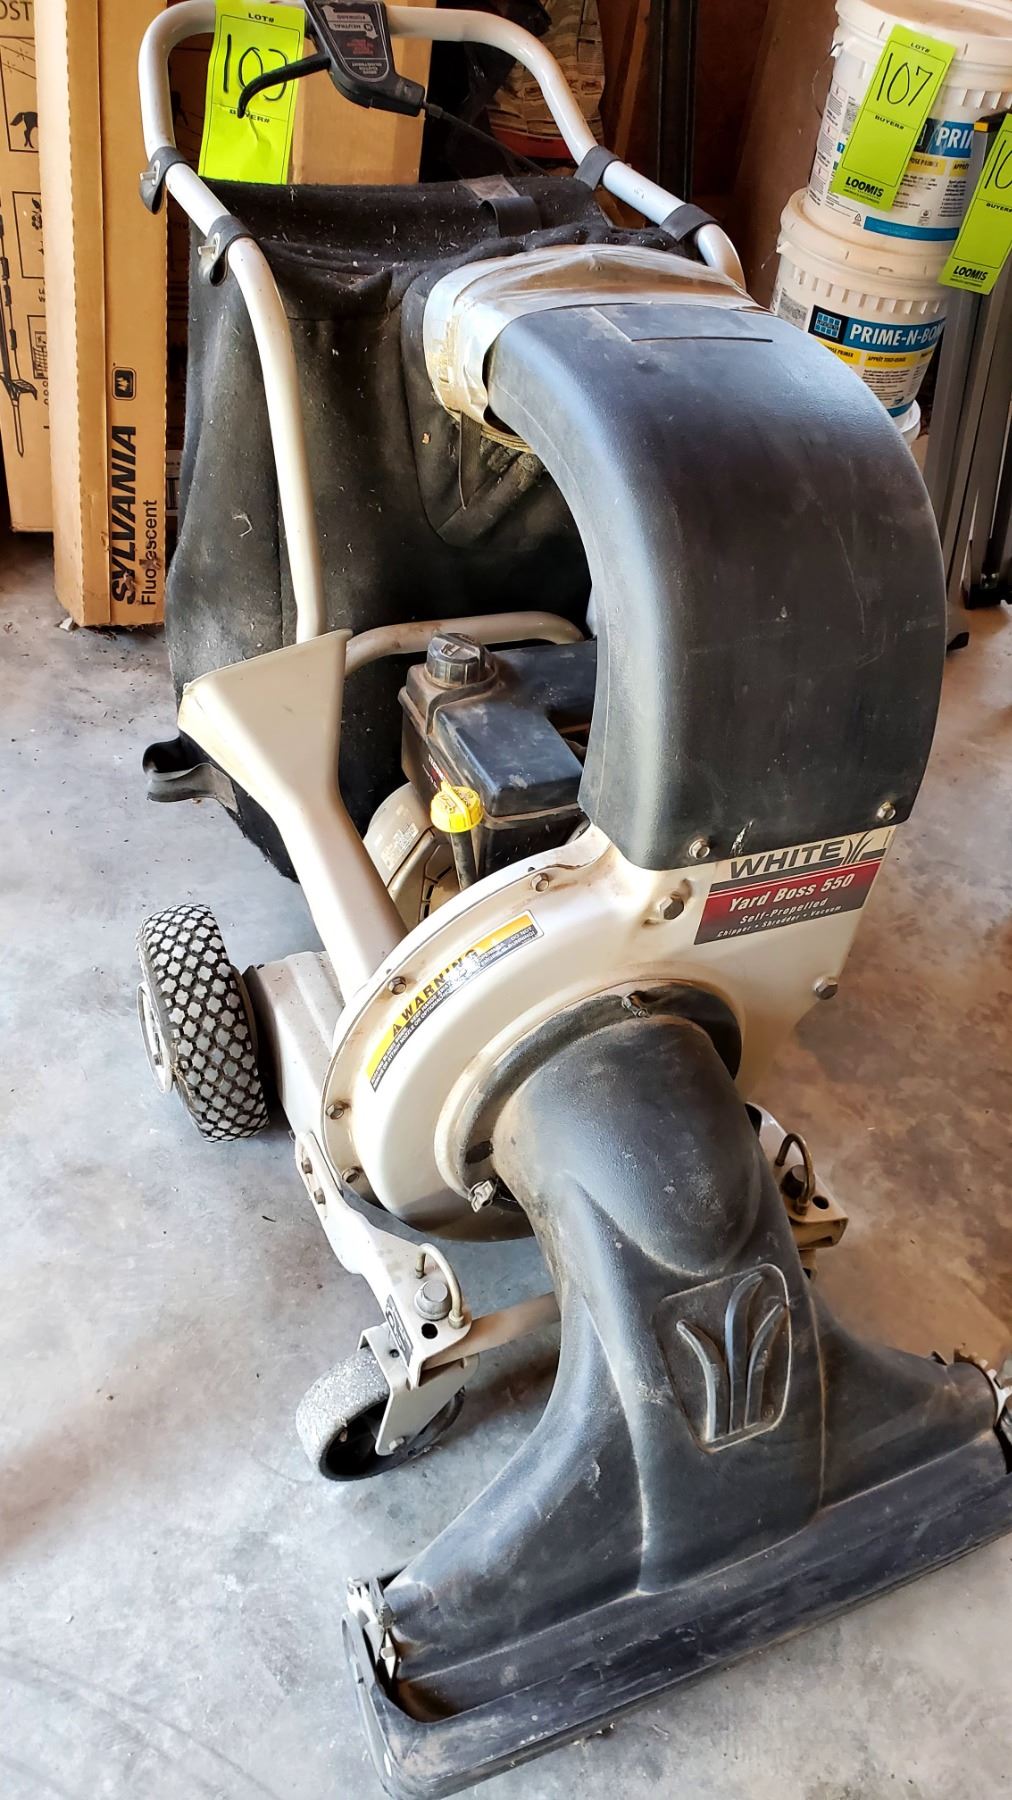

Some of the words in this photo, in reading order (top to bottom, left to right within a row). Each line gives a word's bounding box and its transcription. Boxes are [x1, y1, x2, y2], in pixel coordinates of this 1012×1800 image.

[876, 52, 934, 107] 107
[229, 108, 270, 123] BYER#
[845, 176, 884, 198] LOOMIS
[953, 265, 988, 281] LOOMIS
[849, 321, 945, 346] PRIME-N-BON
[111, 426, 136, 605] SYLVANIA
[140, 500, 158, 605] Fluoescent
[730, 839, 845, 879] WHITE
[728, 891, 772, 913] Yard
[773, 883, 817, 904] Boss
[820, 873, 856, 893] 550
[739, 897, 828, 925] Self-Propelled
[717, 926, 752, 938] Chipper
[761, 914, 800, 928] Shredder
